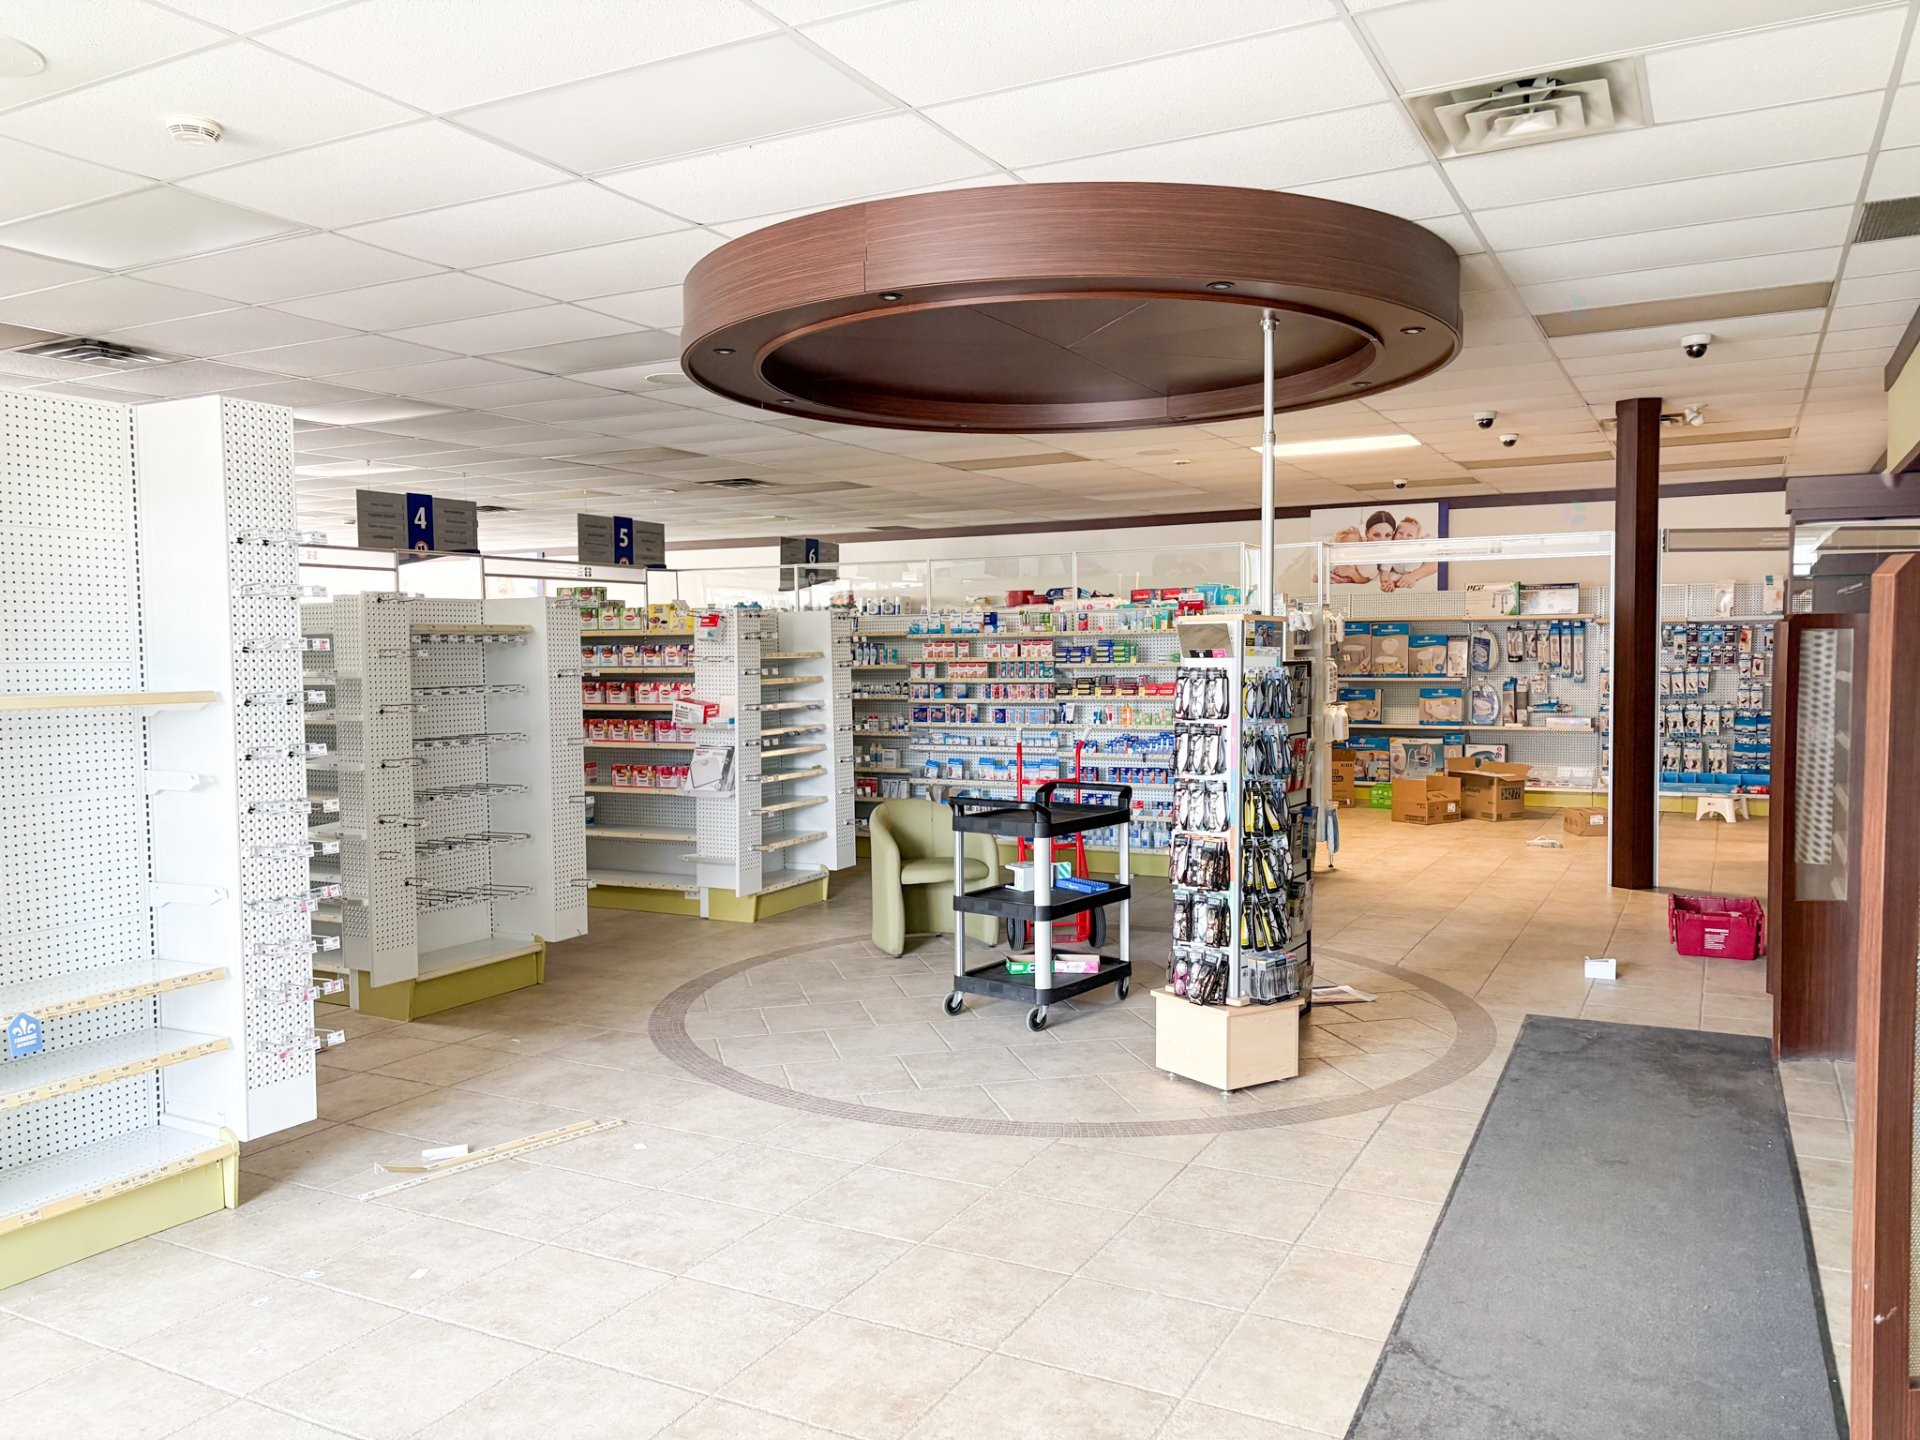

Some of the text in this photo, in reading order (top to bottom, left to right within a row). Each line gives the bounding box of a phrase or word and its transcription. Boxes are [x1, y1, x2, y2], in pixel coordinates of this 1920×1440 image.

[413, 507, 427, 529] 4
[619, 528, 629, 548] 5
[808, 548, 816, 564] 6
